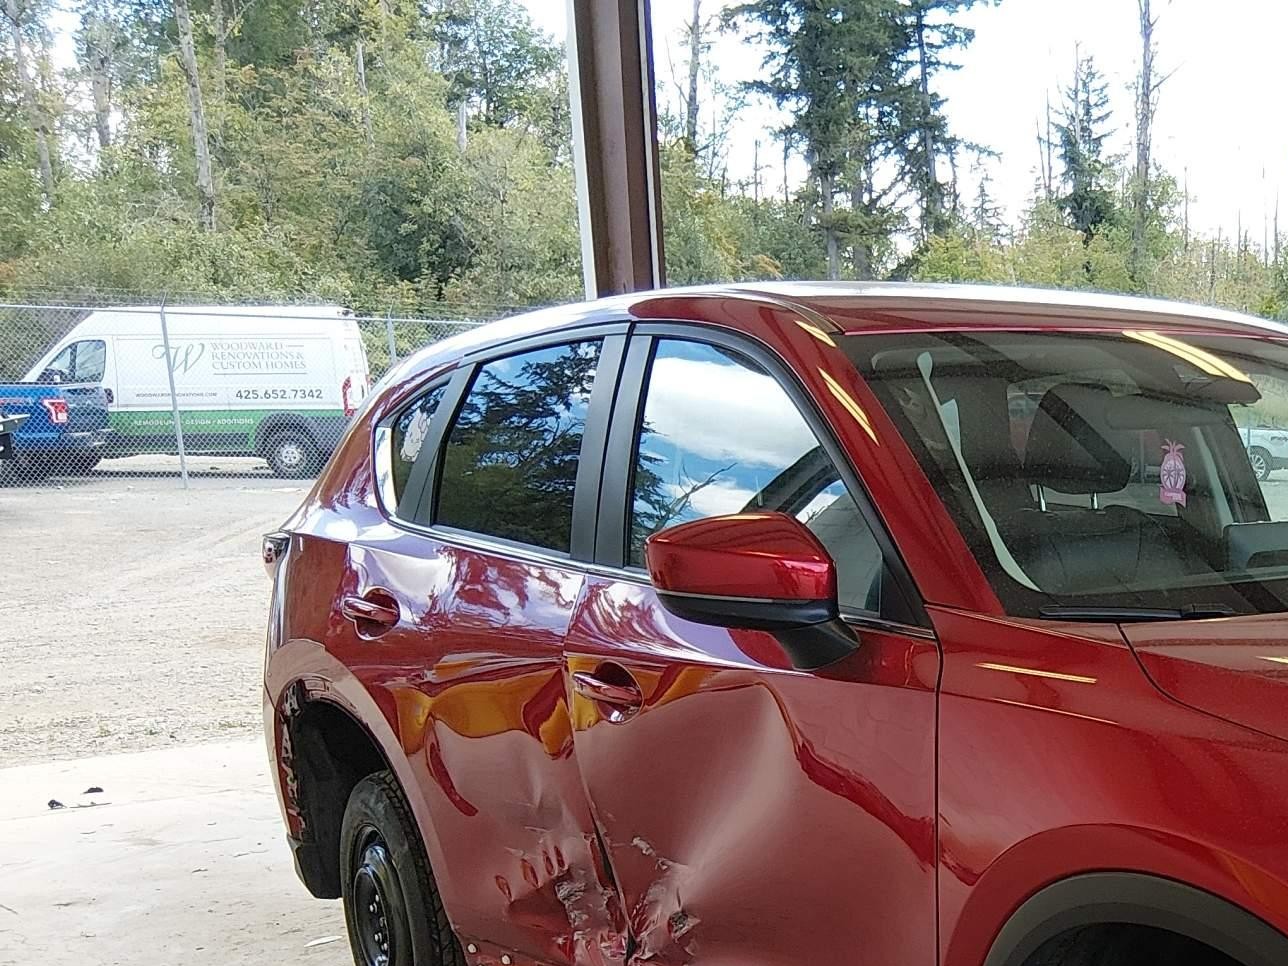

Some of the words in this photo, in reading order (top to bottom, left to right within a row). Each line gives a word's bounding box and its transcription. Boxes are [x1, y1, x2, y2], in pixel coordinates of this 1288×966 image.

[211, 342, 284, 351] WOODWARD
[212, 351, 295, 361] RENOVATIONS
[212, 360, 260, 370] CUSTOM
[264, 360, 307, 370] HOMES
[236, 389, 323, 400] 425.652.7342
